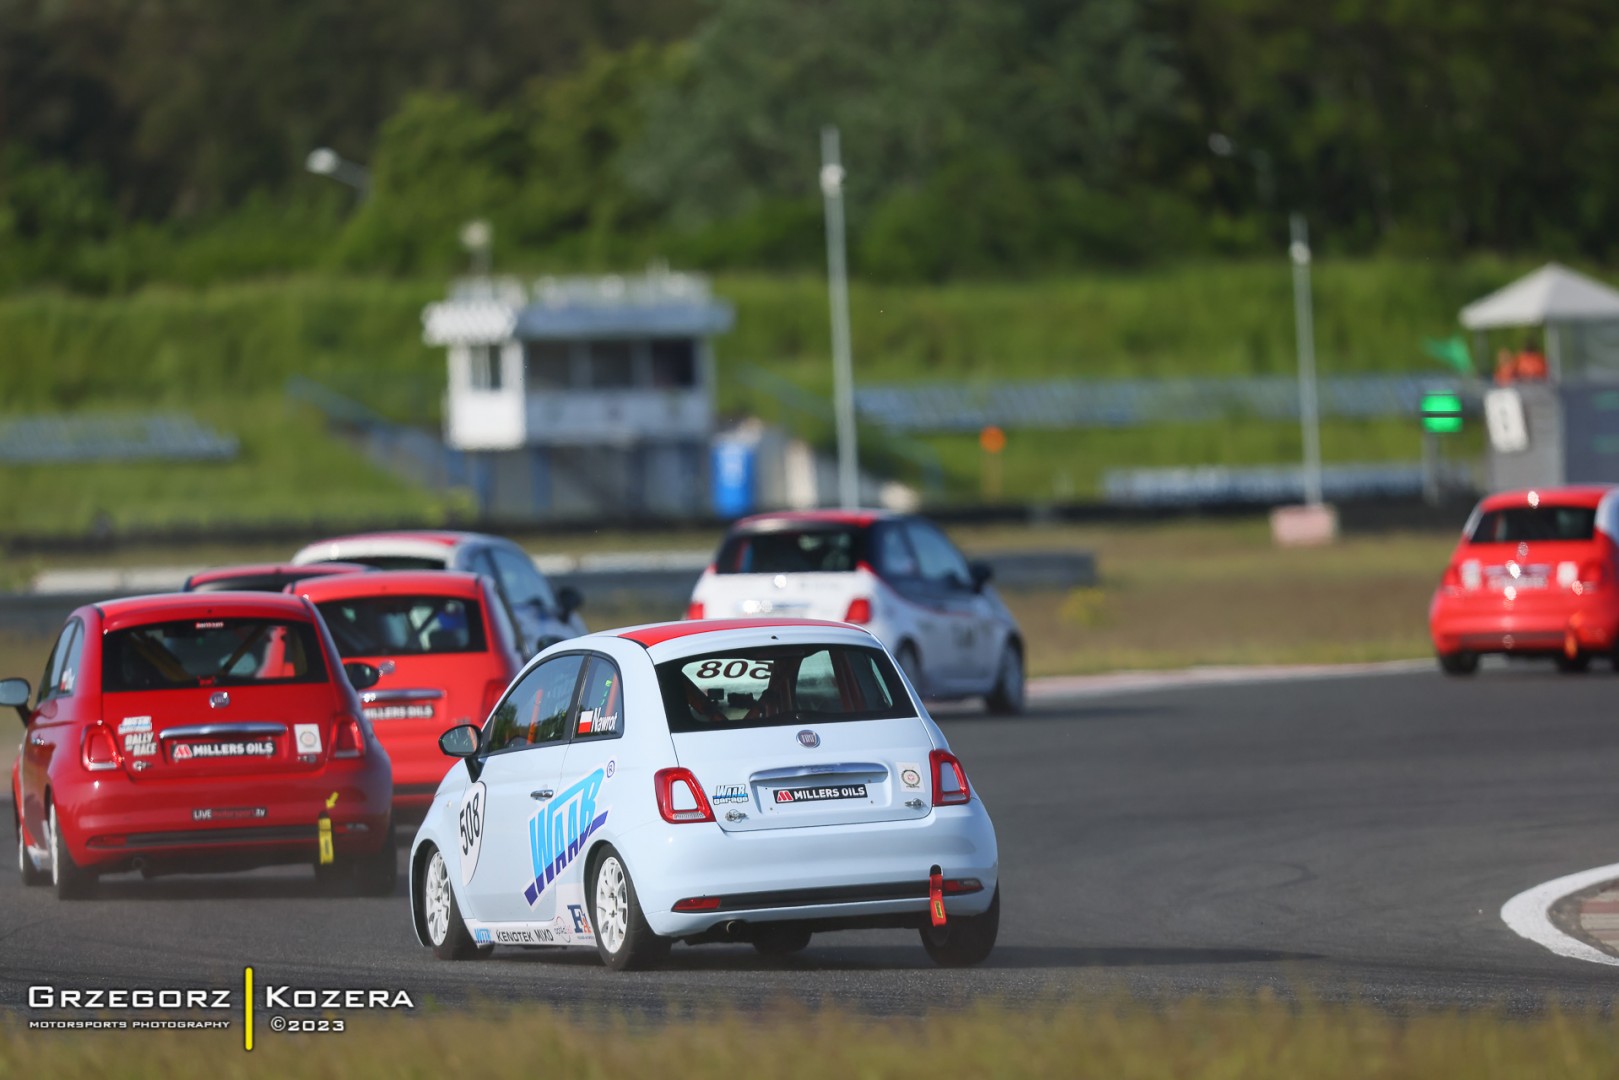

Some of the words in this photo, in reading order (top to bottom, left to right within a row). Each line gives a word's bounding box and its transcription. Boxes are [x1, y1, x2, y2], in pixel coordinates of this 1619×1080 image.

[193, 743, 245, 757] MILLERS
[245, 742, 273, 755] OILS
[794, 788, 840, 801] MILLERS
[842, 786, 866, 797] OILS
[459, 792, 480, 856] 508
